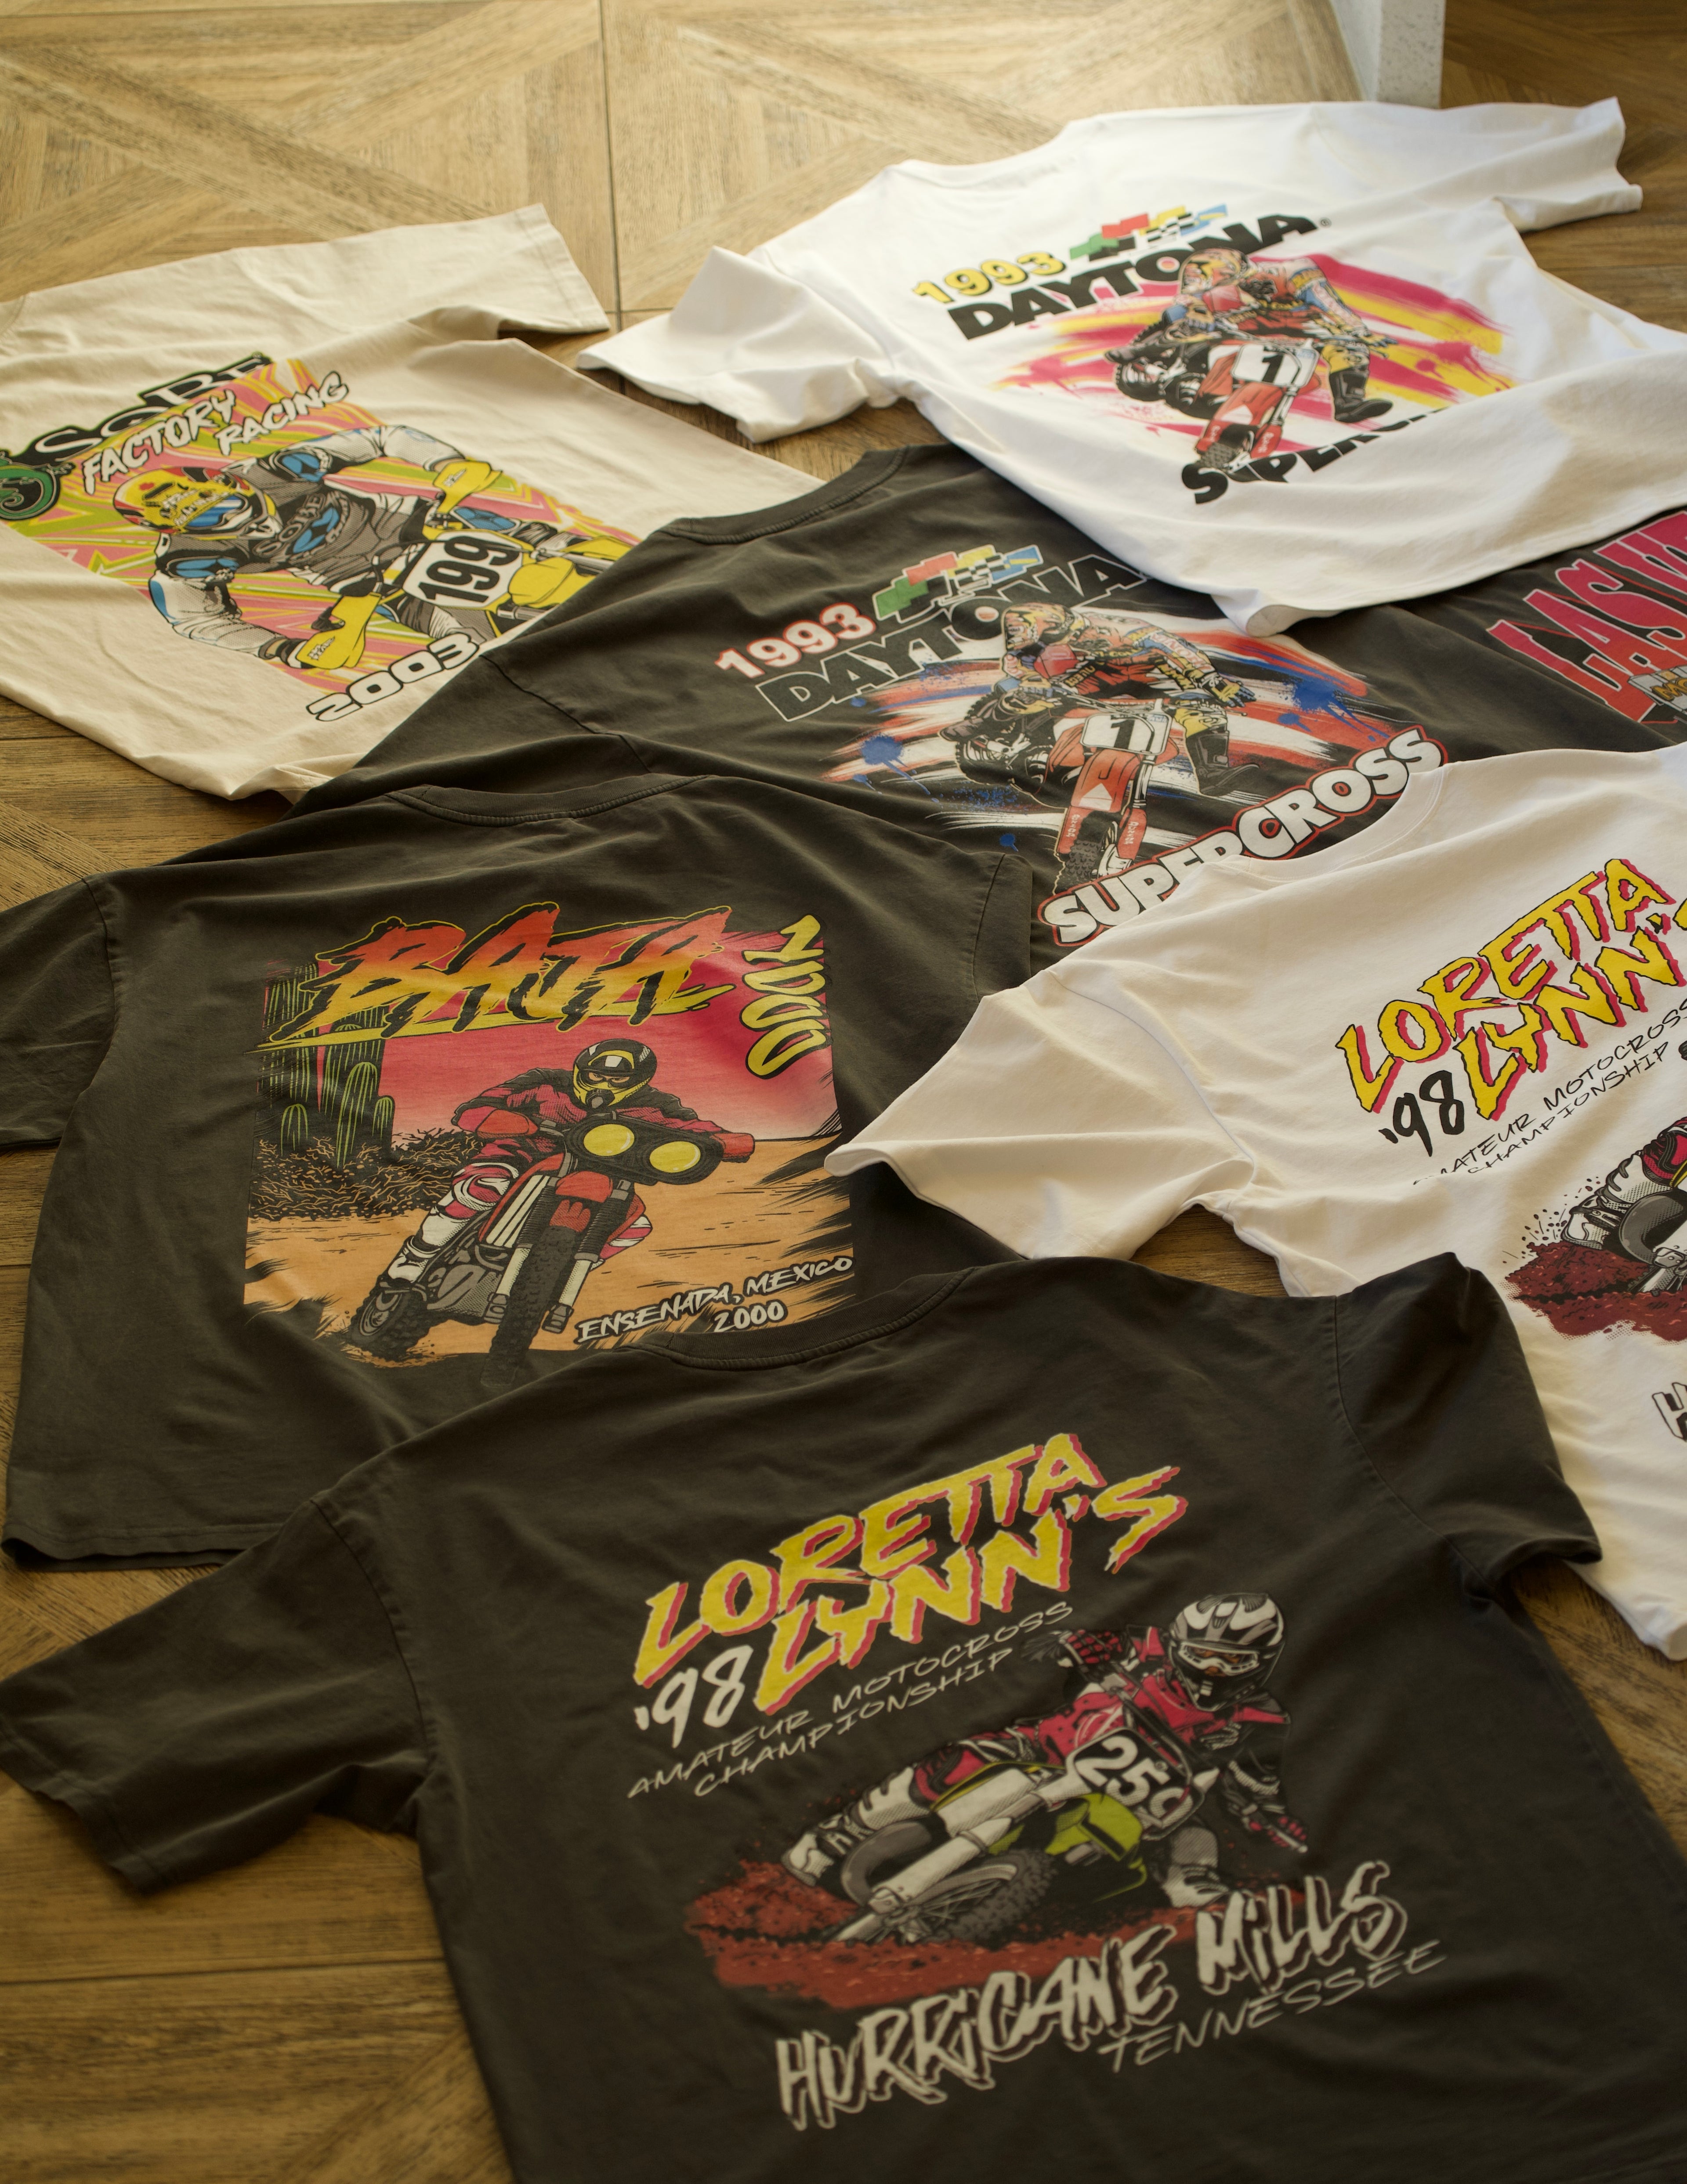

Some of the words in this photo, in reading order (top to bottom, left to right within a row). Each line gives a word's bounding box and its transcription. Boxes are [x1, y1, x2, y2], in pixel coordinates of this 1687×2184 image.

[912, 252, 1067, 304] 1993
[948, 214, 1318, 340] DAYTONA
[214, 370, 349, 456] RACING
[1260, 351, 1284, 383] 1
[82, 389, 236, 495] FACTORY
[417, 535, 520, 603] 199
[306, 632, 479, 722] 2003
[714, 602, 877, 679] 1993
[755, 554, 1148, 722] DAYTONA
[1109, 719, 1135, 748] 1
[269, 901, 733, 1042] BAJA
[739, 913, 832, 1079] 1000
[1335, 858, 1676, 1114] LORETTA
[1413, 1113, 1536, 1185] ATEUR
[1467, 1041, 1669, 1173] CHAMPIONSHIP
[713, 1300, 786, 1333] 2000
[746, 1257, 854, 1297] MEXICO
[633, 1433, 1107, 1688] LORETTA
[753, 1466, 1188, 1715] LYNN'S
[627, 1710, 814, 1798] AMATEUR
[832, 1601, 1073, 1714] MOTOCROSS
[694, 1647, 1013, 1796] CHAMPIONSHIP
[1097, 1938, 1447, 2073] TENNESSEE
